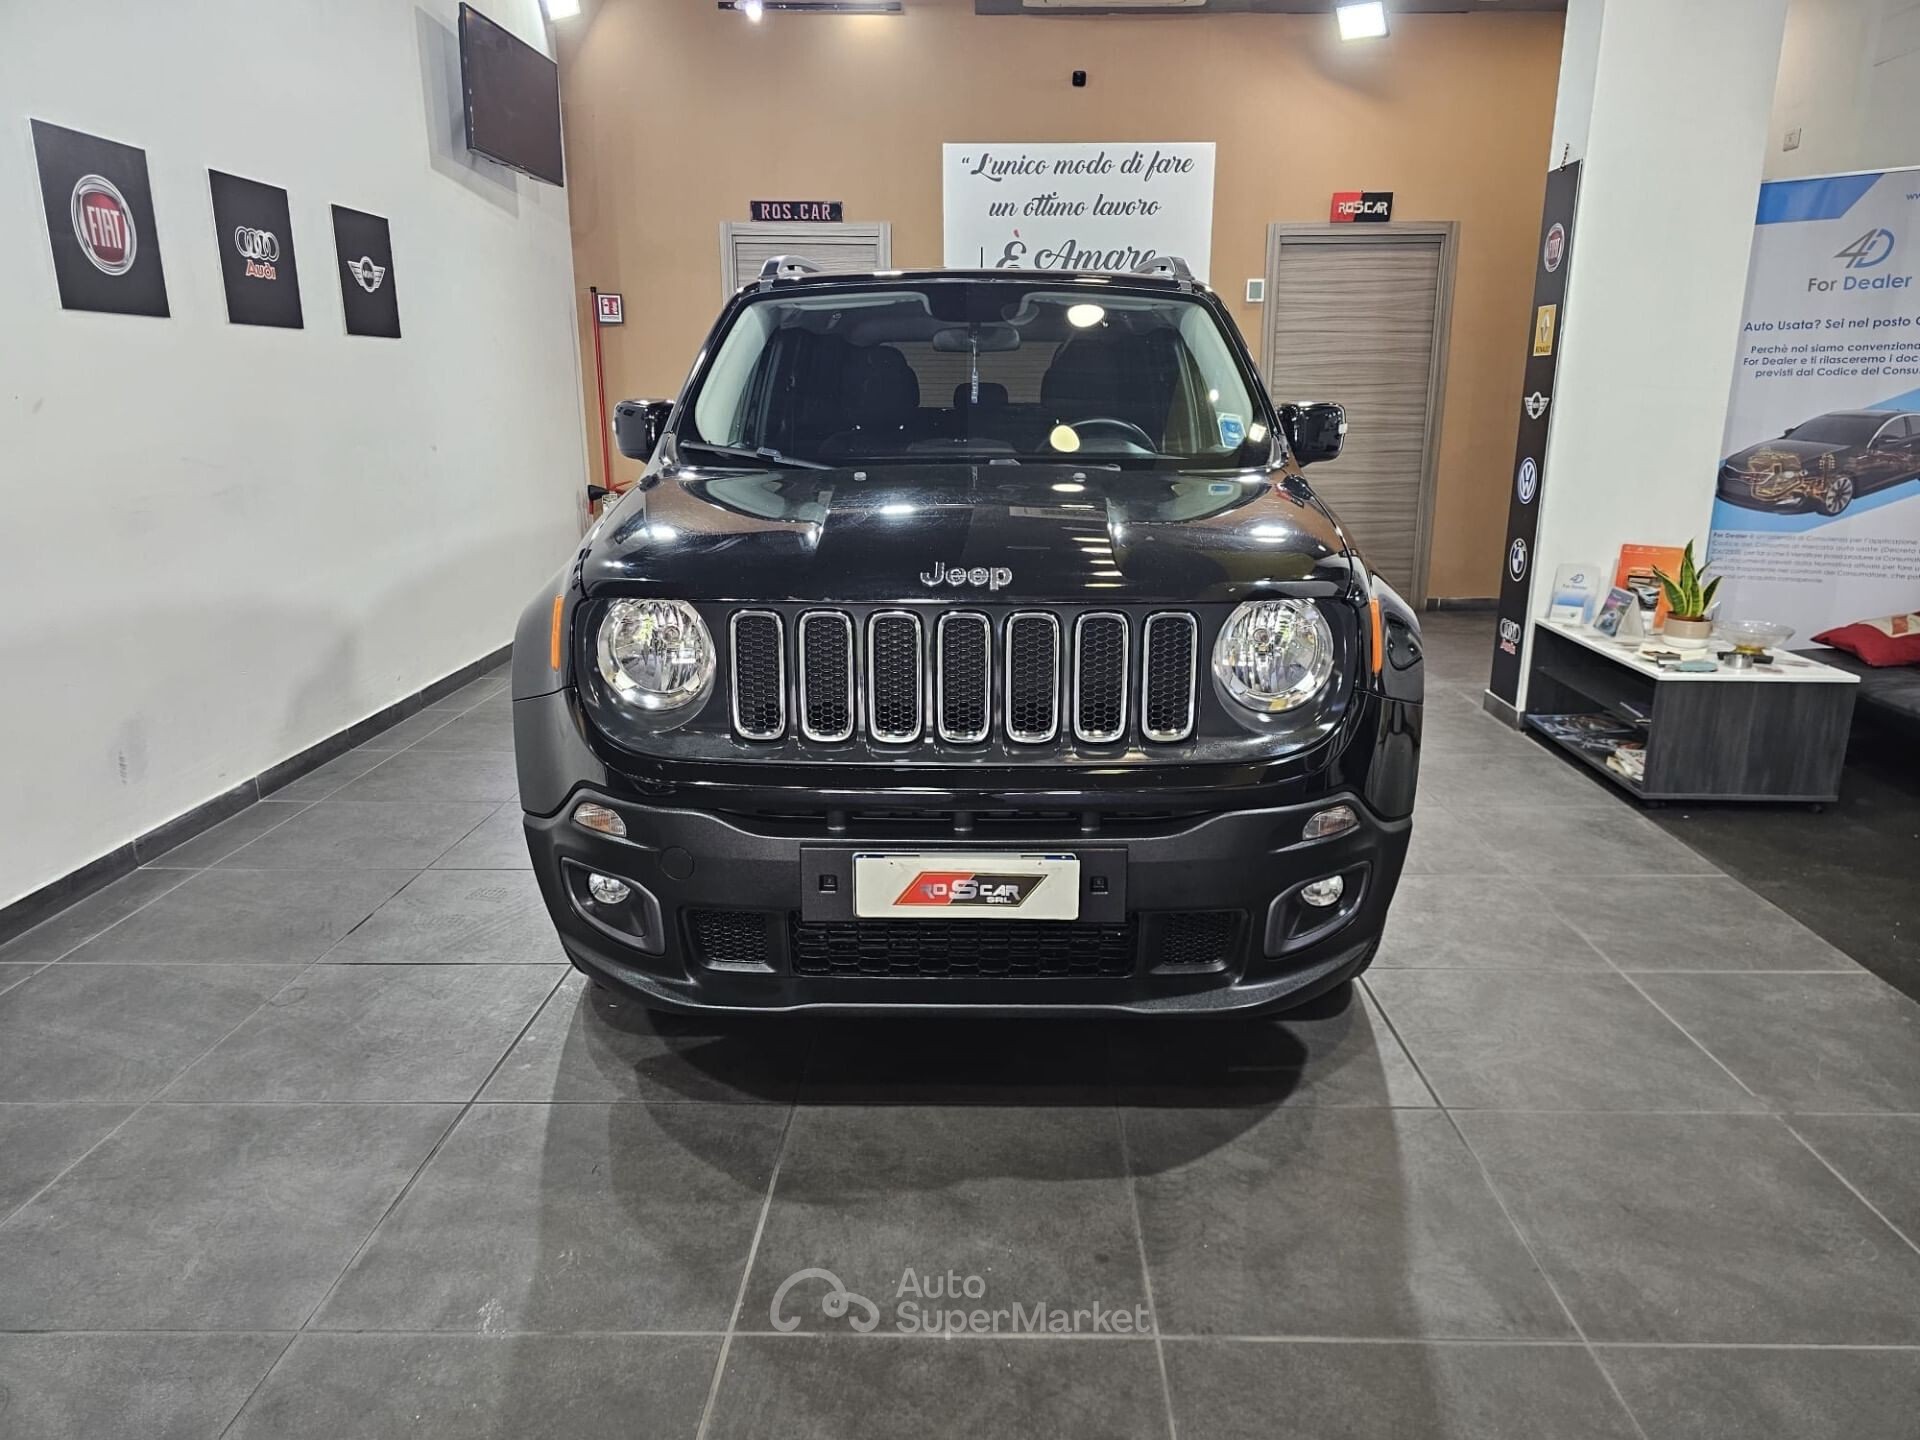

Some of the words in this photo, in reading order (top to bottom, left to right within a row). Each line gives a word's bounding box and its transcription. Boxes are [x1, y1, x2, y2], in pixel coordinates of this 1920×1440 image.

[1053, 151, 1115, 175] modo
[1120, 150, 1145, 174] di
[1143, 150, 1195, 181] fare
[988, 200, 1017, 217] un
[1023, 191, 1088, 216] ottimo
[1092, 193, 1161, 216] lavoro
[87, 205, 122, 248] FIAT
[246, 260, 276, 280] Audi
[1808, 278, 1838, 292] For
[1843, 274, 1912, 290] Dealer
[1744, 322, 1774, 332] Auto
[1778, 320, 1821, 330] Usata?
[1825, 318, 1845, 329] Sei
[1848, 317, 1869, 328] nel
[1873, 316, 1911, 330] posto
[1791, 344, 1809, 353] noi
[1811, 343, 1844, 353] siamo
[1743, 357, 1759, 366] For
[1762, 356, 1797, 366] Dealer
[1800, 357, 1808, 365] e
[1820, 354, 1886, 365] rilasceremo
[1895, 353, 1920, 363] doc
[1755, 369, 1793, 379] previsti
[1796, 368, 1814, 377] dal
[1817, 366, 1858, 377] Codice
[1861, 366, 1880, 376] del
[1882, 366, 1920, 375] Consu
[920, 561, 1012, 590] Jeep
[986, 896, 1011, 904] SRL
